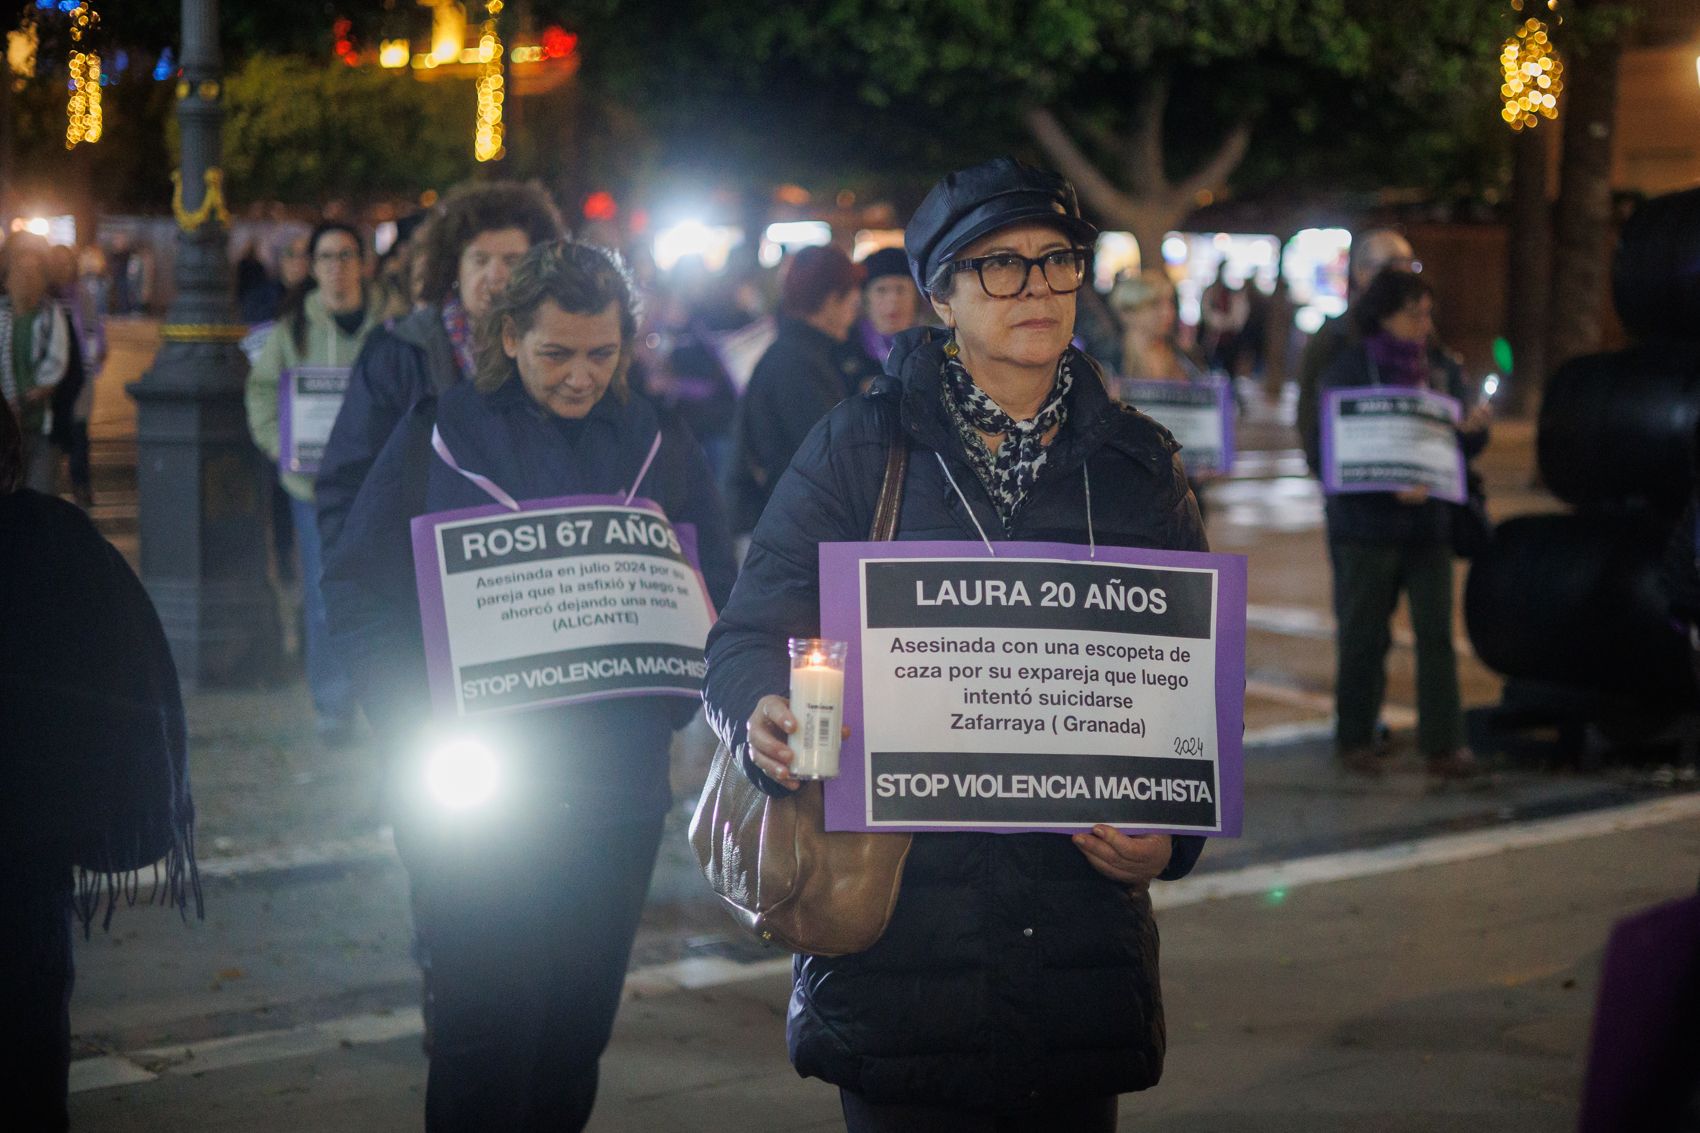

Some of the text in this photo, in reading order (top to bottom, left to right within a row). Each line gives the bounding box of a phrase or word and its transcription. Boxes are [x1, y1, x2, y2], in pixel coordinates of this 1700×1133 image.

[461, 513, 682, 560] ROSI 67 AÑOS
[476, 568, 552, 590] Asesinada
[558, 566, 576, 578] en
[579, 560, 611, 578] julio
[615, 559, 646, 573] 2024
[650, 564, 670, 577] por
[476, 588, 524, 608] pareja
[527, 587, 556, 603] que
[559, 581, 574, 595] la
[577, 577, 625, 593] asfixió
[629, 579, 638, 593] y
[640, 578, 674, 594] luego
[915, 578, 1168, 615] LAURA 20 AÑOS
[501, 595, 678, 621] ahorcó dejando una nota
[552, 610, 640, 633] (ALICANTE)
[890, 637, 1191, 663] Asesinada con una escopeta de
[463, 673, 520, 699] STOP
[520, 658, 634, 690] VIOLENCIA
[894, 664, 1190, 690] caza por su expareja que luego
[963, 687, 1134, 709] intentó suicidarse
[950, 713, 1046, 735] Zafarraya
[1173, 736, 1204, 757] 2024
[876, 774, 1213, 803] STOP VIOLENCIA MACHISTA
